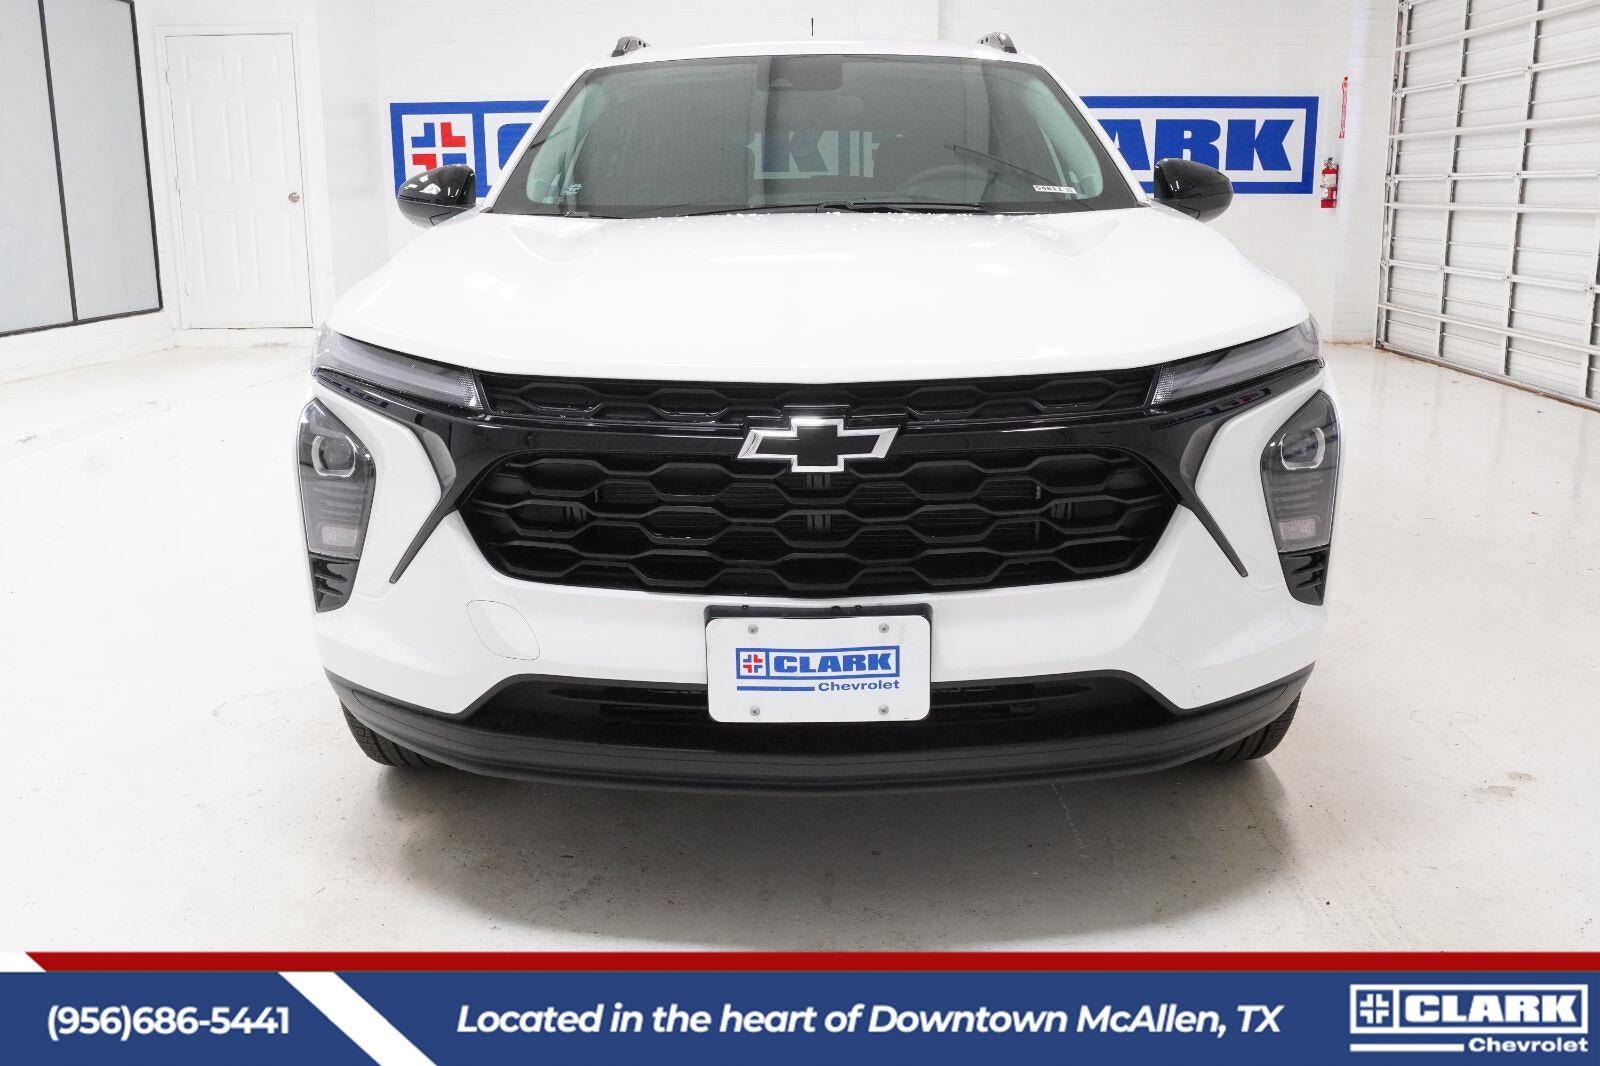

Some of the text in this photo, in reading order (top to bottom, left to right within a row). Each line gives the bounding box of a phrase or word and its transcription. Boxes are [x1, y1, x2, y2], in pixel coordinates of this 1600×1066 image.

[1097, 119, 1295, 171] ARK
[773, 652, 892, 674] CLARK
[818, 680, 900, 692] Chevrolet
